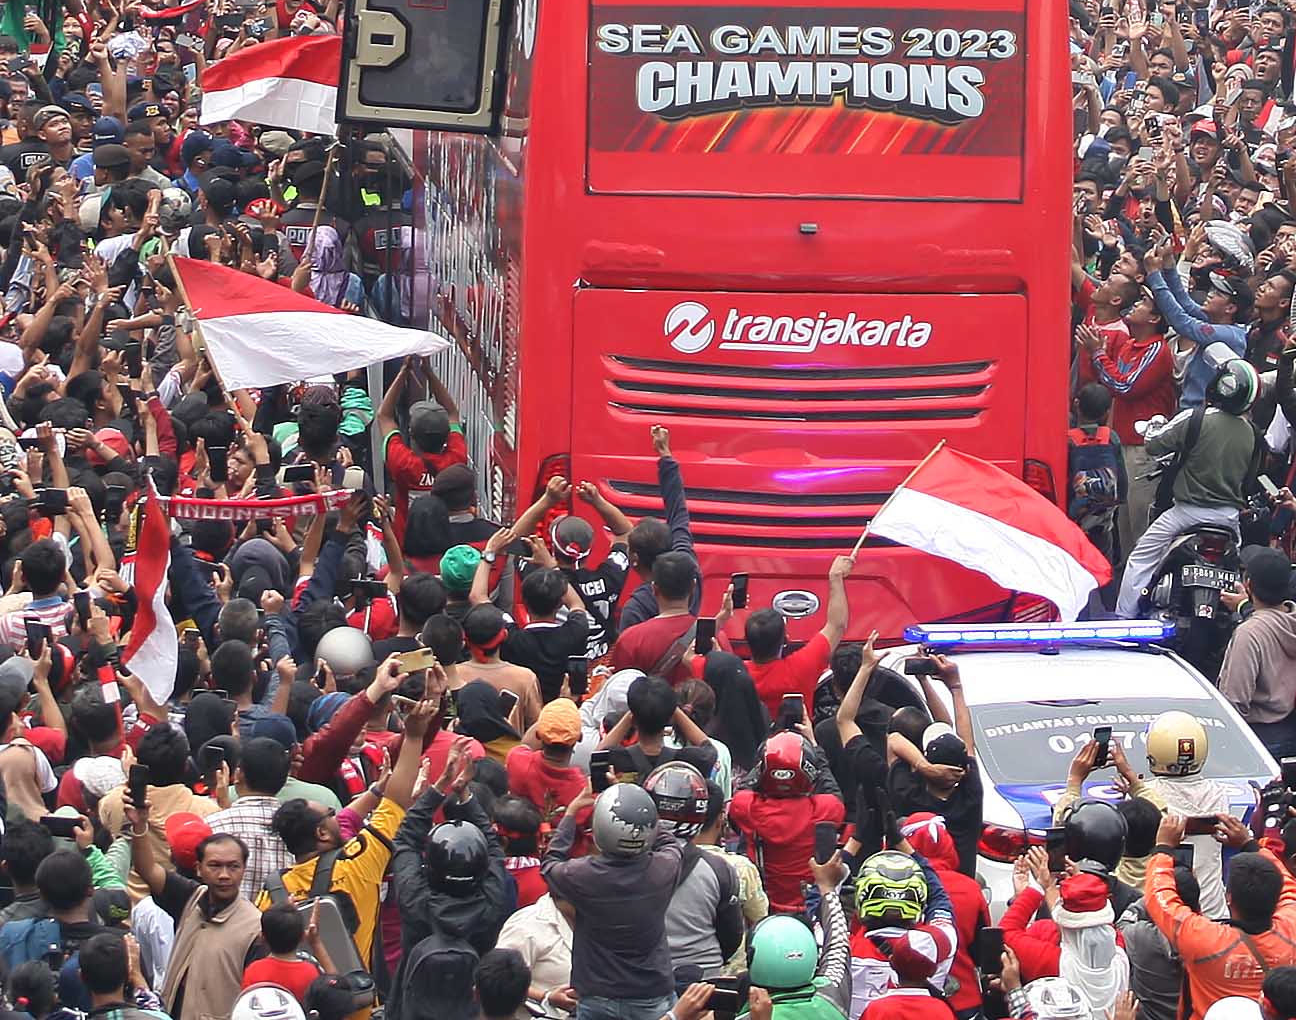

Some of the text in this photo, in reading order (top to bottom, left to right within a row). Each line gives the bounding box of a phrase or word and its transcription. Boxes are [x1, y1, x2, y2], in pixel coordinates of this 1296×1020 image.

[595, 24, 1019, 60] SEA GAMES 2023
[635, 60, 987, 120] CHAMPIONS
[718, 306, 934, 353] transjakarta
[175, 502, 318, 520] INDONESIA
[985, 716, 1073, 738] DITLANTAS
[1076, 714, 1129, 726] POLDA
[1048, 731, 1148, 755] 017
